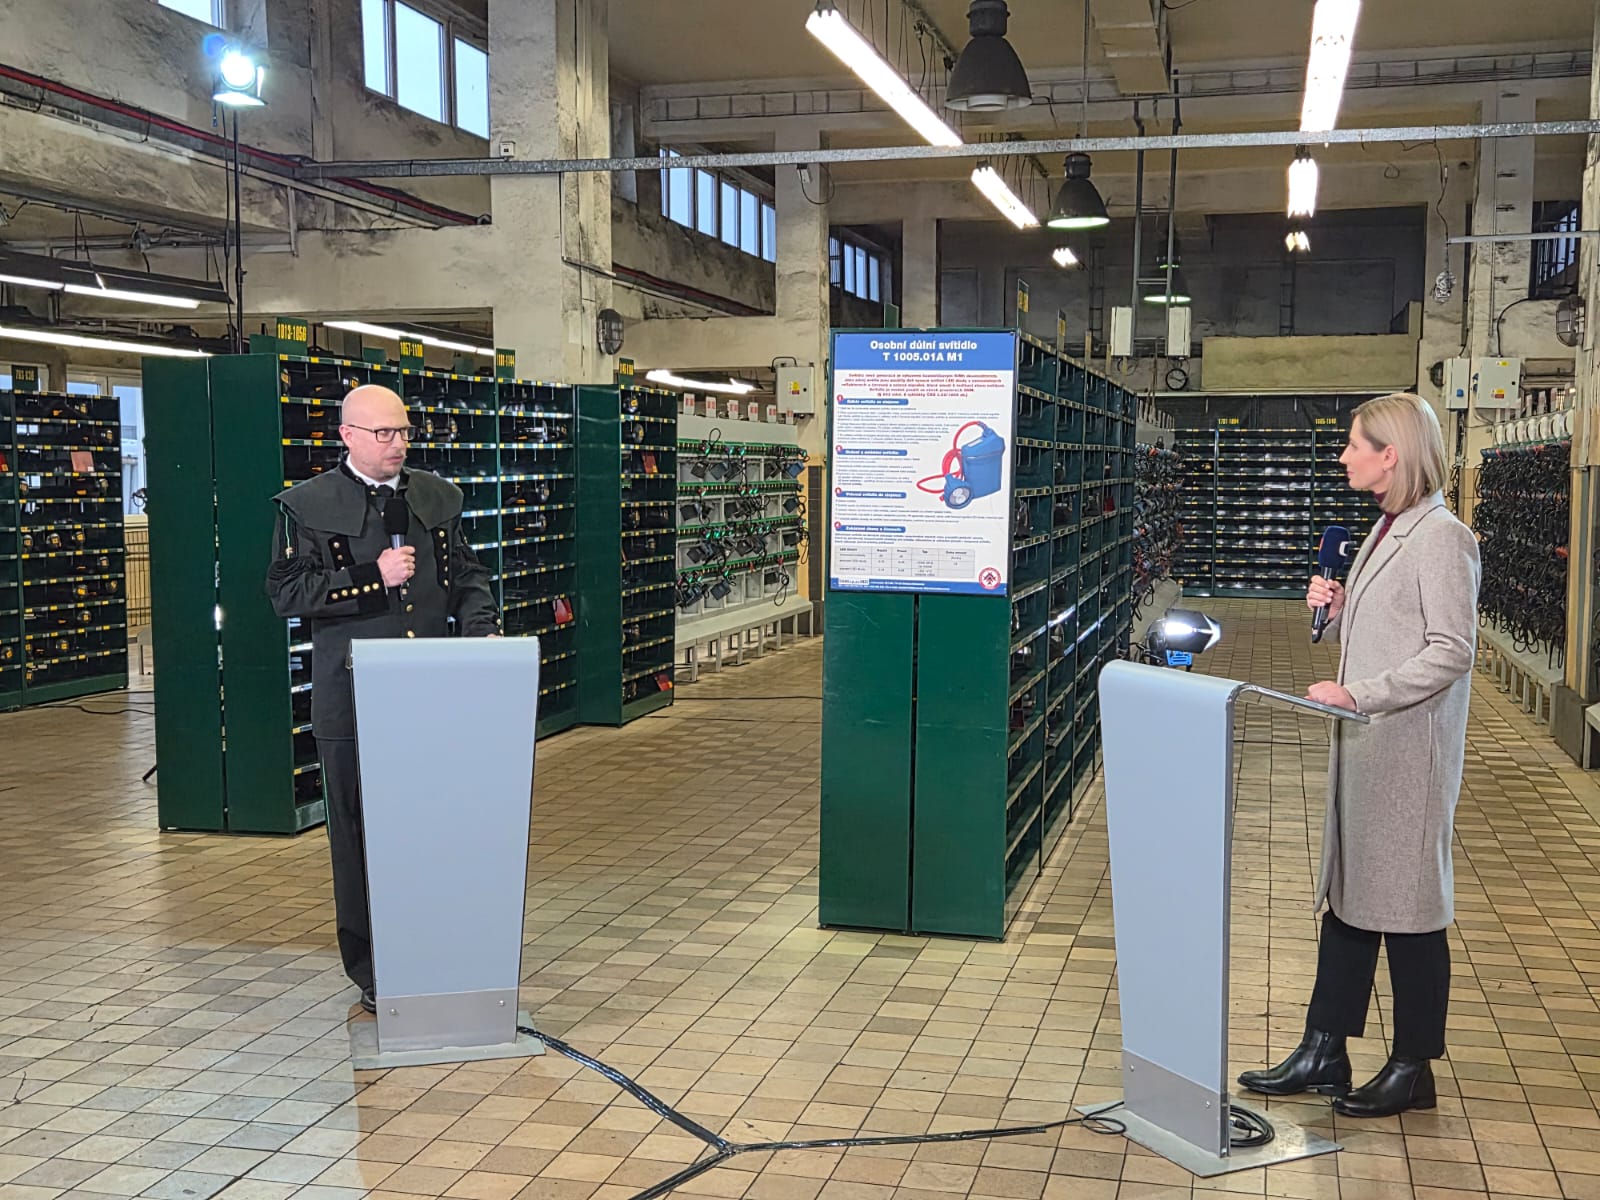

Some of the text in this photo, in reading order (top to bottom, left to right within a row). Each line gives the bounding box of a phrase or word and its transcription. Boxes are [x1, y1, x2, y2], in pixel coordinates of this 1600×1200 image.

[870, 340, 977, 350] Osobní důlní svítidlo
[883, 352, 963, 361] T 1005.01A M1
